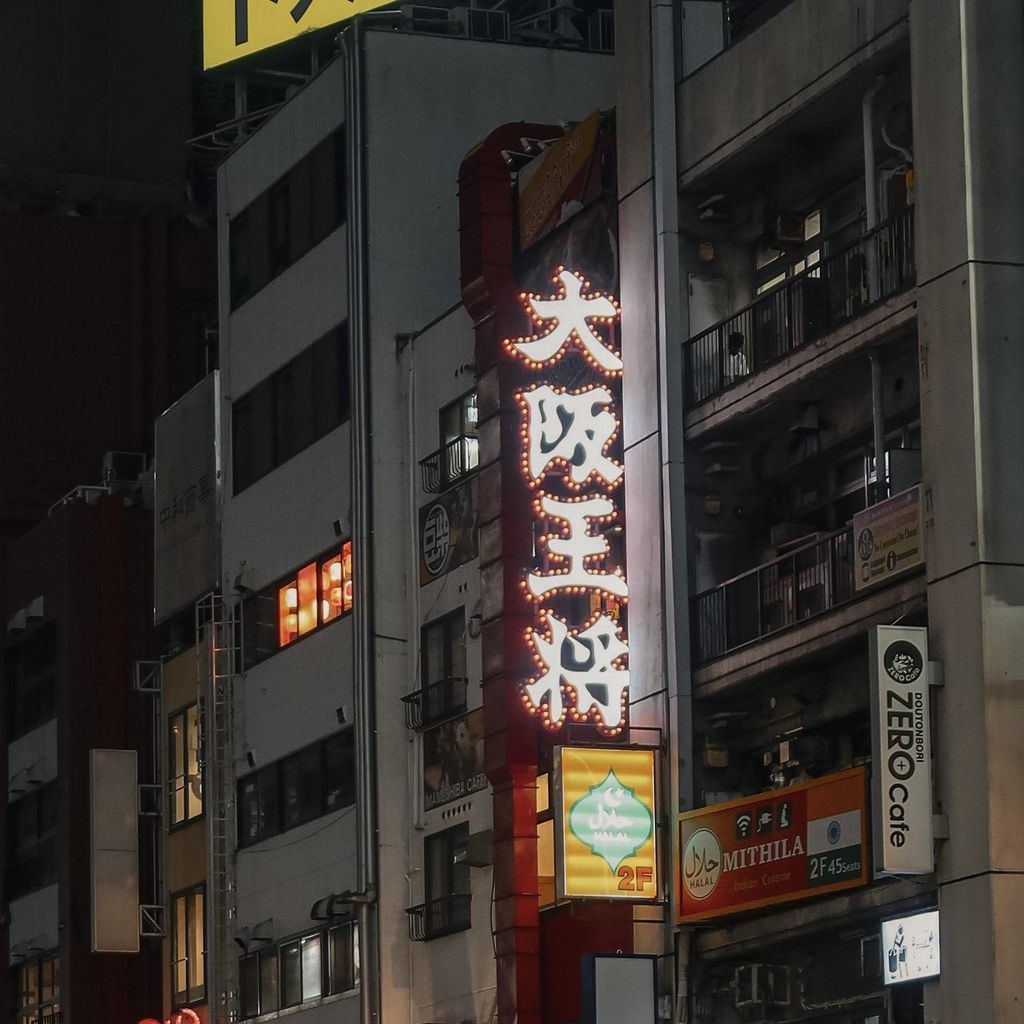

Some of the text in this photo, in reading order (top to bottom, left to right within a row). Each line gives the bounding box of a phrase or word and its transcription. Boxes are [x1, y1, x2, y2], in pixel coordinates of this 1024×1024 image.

[508, 268, 629, 730] 大阪王将
[915, 693, 925, 763] DOUTONBORI
[685, 845, 719, 879] حلال
[723, 835, 805, 873] MITHILA
[810, 858, 827, 880] 2F
[617, 865, 653, 891] 2F
[689, 876, 714, 888] HALAL
[762, 871, 791, 886] Cuisine
